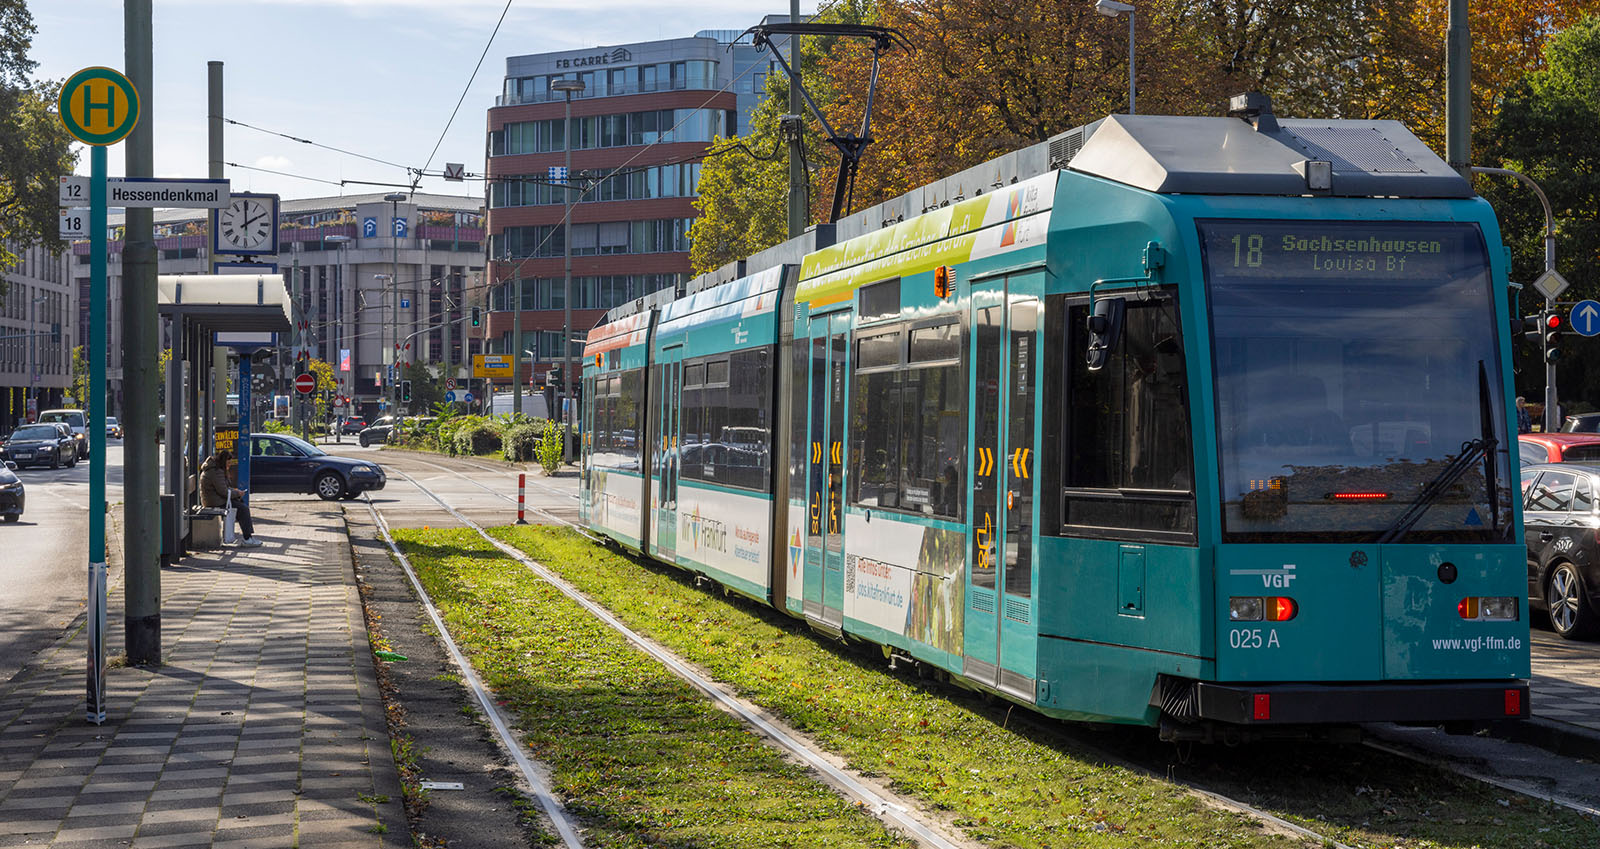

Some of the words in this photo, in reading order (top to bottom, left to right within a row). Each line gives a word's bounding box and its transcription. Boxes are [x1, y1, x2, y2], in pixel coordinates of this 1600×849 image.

[556, 59, 570, 69] FB
[573, 52, 609, 67] CARRÉ
[84, 85, 115, 128] H
[66, 184, 81, 197] 12
[112, 188, 219, 203] Hessendenkmal
[65, 216, 81, 231] 18
[1231, 233, 1264, 267] 18
[1282, 234, 1441, 253] Sachsenhausen
[1313, 254, 1377, 271] Louisa
[1386, 255, 1407, 271] Bf
[1262, 564, 1296, 588] VGF
[1230, 628, 1263, 649] 025
[1267, 628, 1280, 648] A
[1432, 636, 1521, 653] www.vgf-ffm.de
